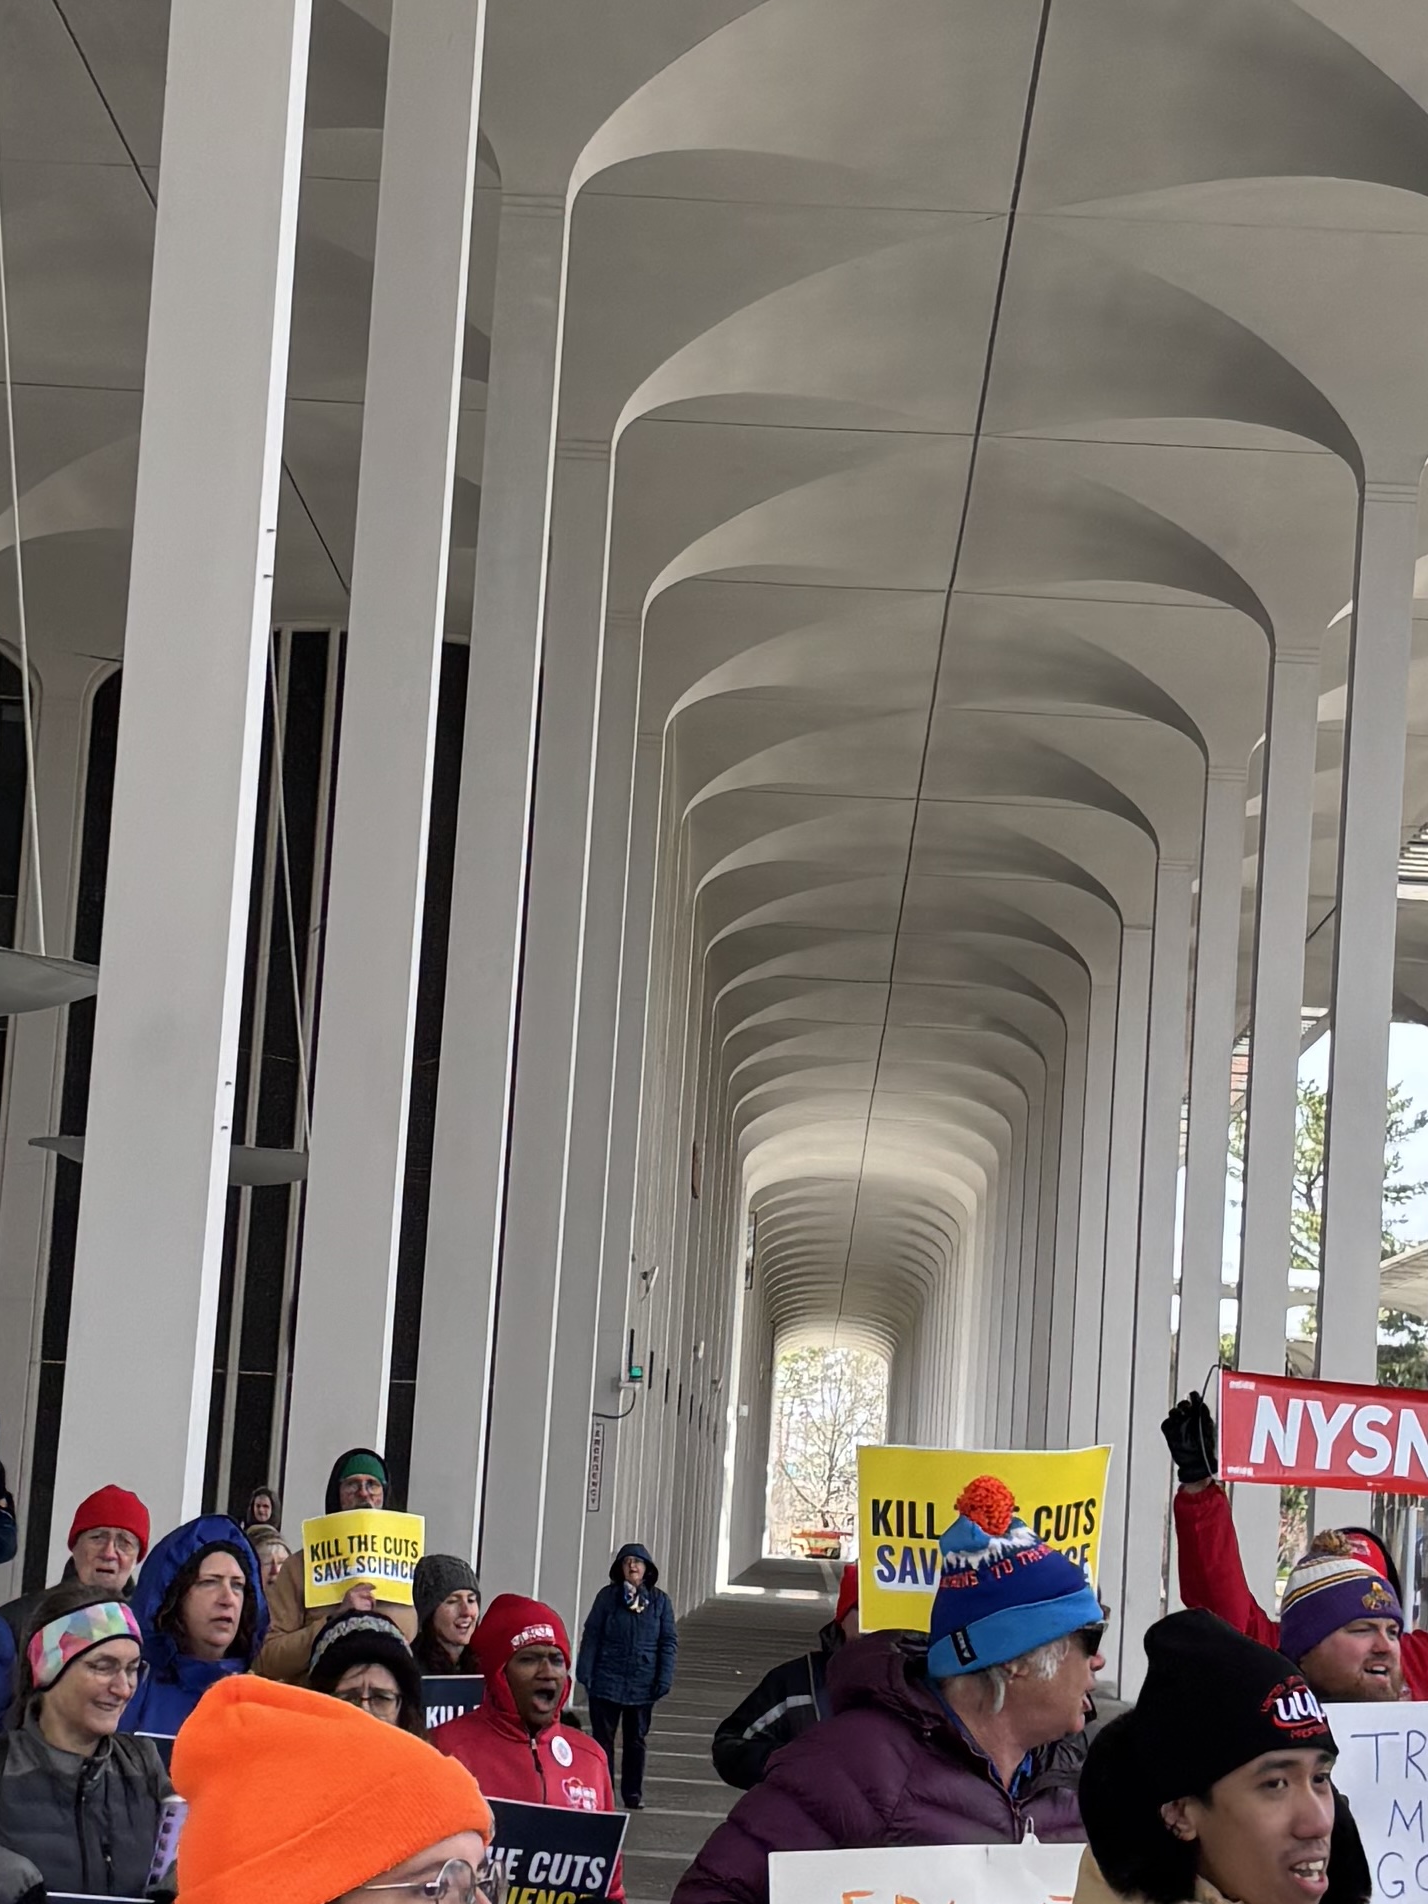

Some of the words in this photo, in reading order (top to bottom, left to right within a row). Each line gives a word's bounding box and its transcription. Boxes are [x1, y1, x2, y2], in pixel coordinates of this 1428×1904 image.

[872, 1499, 941, 1540] KILL
[1033, 1498, 1096, 1542] CUTS
[310, 1538, 342, 1562] KILL
[347, 1534, 378, 1553] THE
[383, 1536, 419, 1558] CUTS
[876, 1545, 938, 1585] SAV
[314, 1557, 350, 1583] SAVE
[528, 1851, 606, 1890] CUTS
